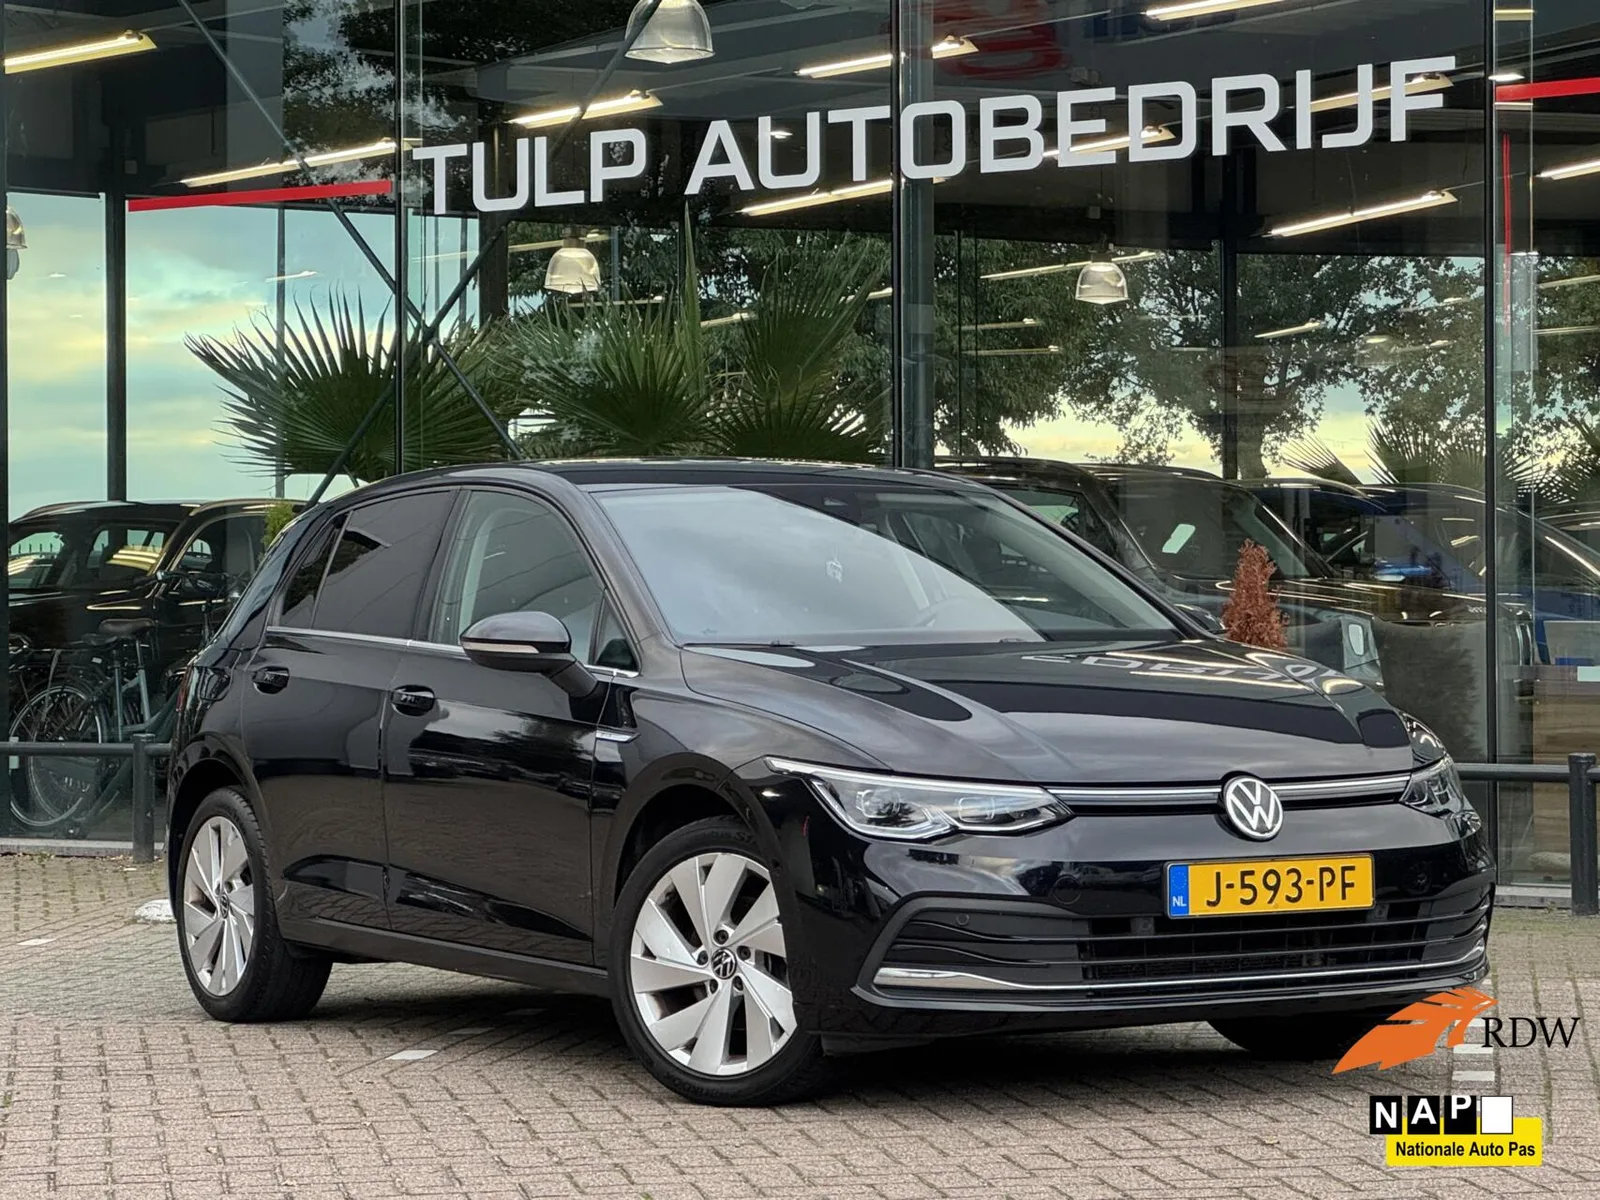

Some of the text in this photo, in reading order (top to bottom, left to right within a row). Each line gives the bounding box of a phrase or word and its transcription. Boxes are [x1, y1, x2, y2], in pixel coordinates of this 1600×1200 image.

[412, 56, 1455, 215] TULP AUTOBEDRIJF
[1226, 777, 1282, 837] VW
[1172, 895, 1188, 907] NL
[1206, 865, 1356, 908] J-593-PF
